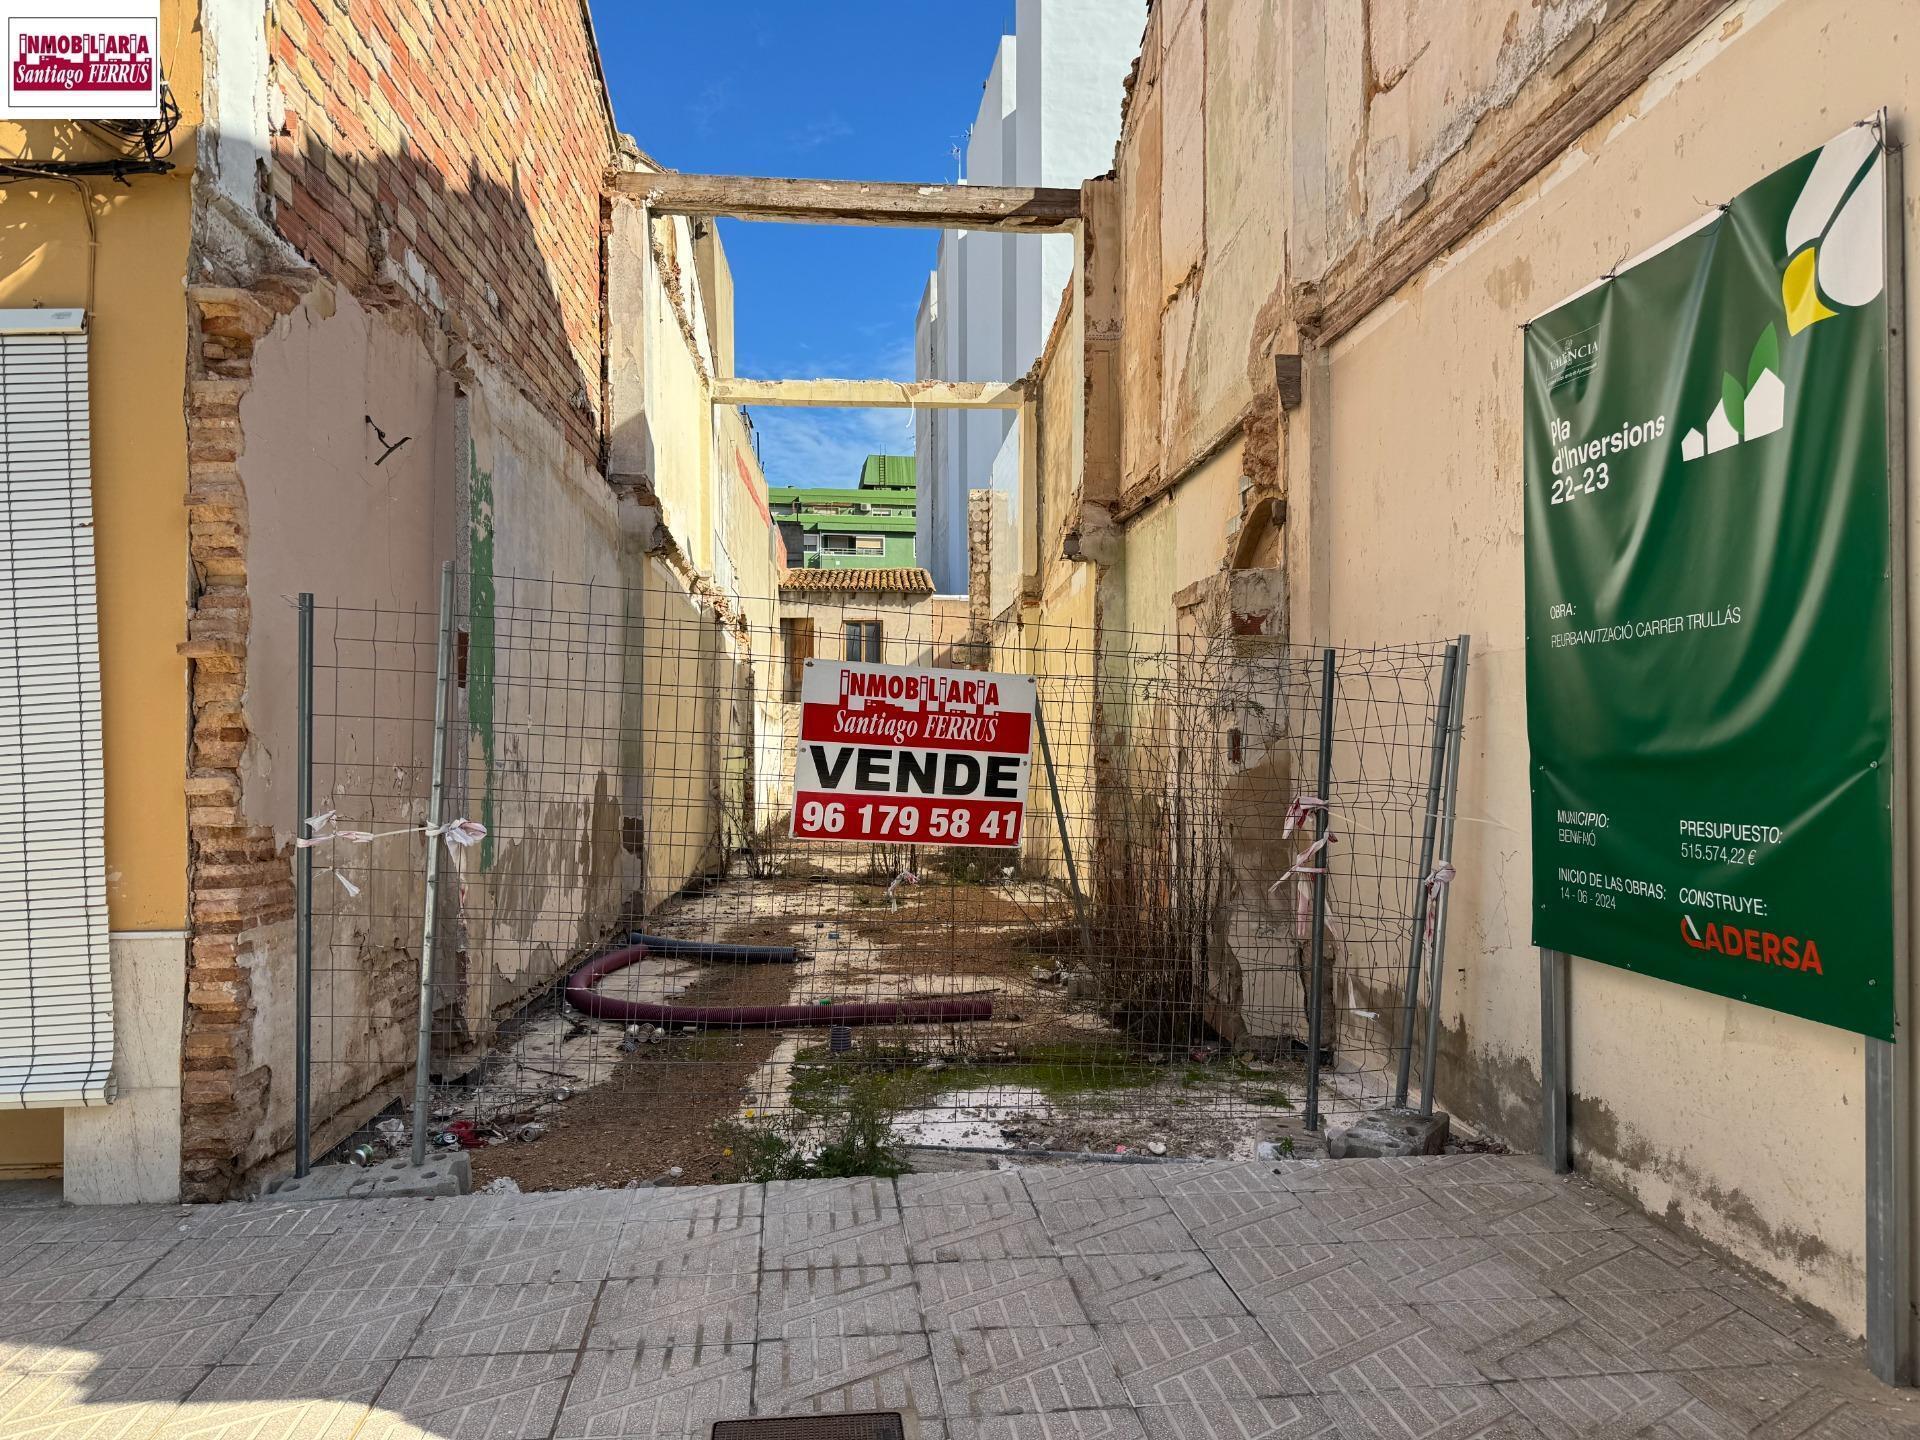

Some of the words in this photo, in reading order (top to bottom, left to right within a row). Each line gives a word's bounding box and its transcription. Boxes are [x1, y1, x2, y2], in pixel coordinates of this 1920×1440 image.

[1550, 417, 1571, 446] Pla
[1552, 415, 1665, 476] d'Inversions
[1550, 603, 1577, 620] OBRA:
[1636, 617, 1684, 638] CARRER
[1686, 604, 1741, 630] TRULLÁS
[834, 710, 918, 744] Santiago
[810, 745, 1021, 798] VENDE
[802, 801, 846, 832] 96
[858, 804, 920, 836] 179
[929, 808, 971, 838] 58
[980, 810, 1018, 839] 41
[1557, 809, 1610, 829] MUNICIPIO:
[1680, 820, 1783, 844] PRESUPUESTO:
[1681, 842, 1746, 865] 515.574,22
[1748, 849, 1756, 865] €
[1558, 867, 1588, 885] INICIO
[1589, 872, 1603, 888] DE
[1604, 876, 1624, 893] LAS
[1624, 879, 1667, 900] OBRAS:
[1560, 886, 1571, 899] 14
[1577, 889, 1588, 903] 06
[1595, 892, 1616, 909] 2024
[1679, 888, 1768, 916] CONSTRUYE:
